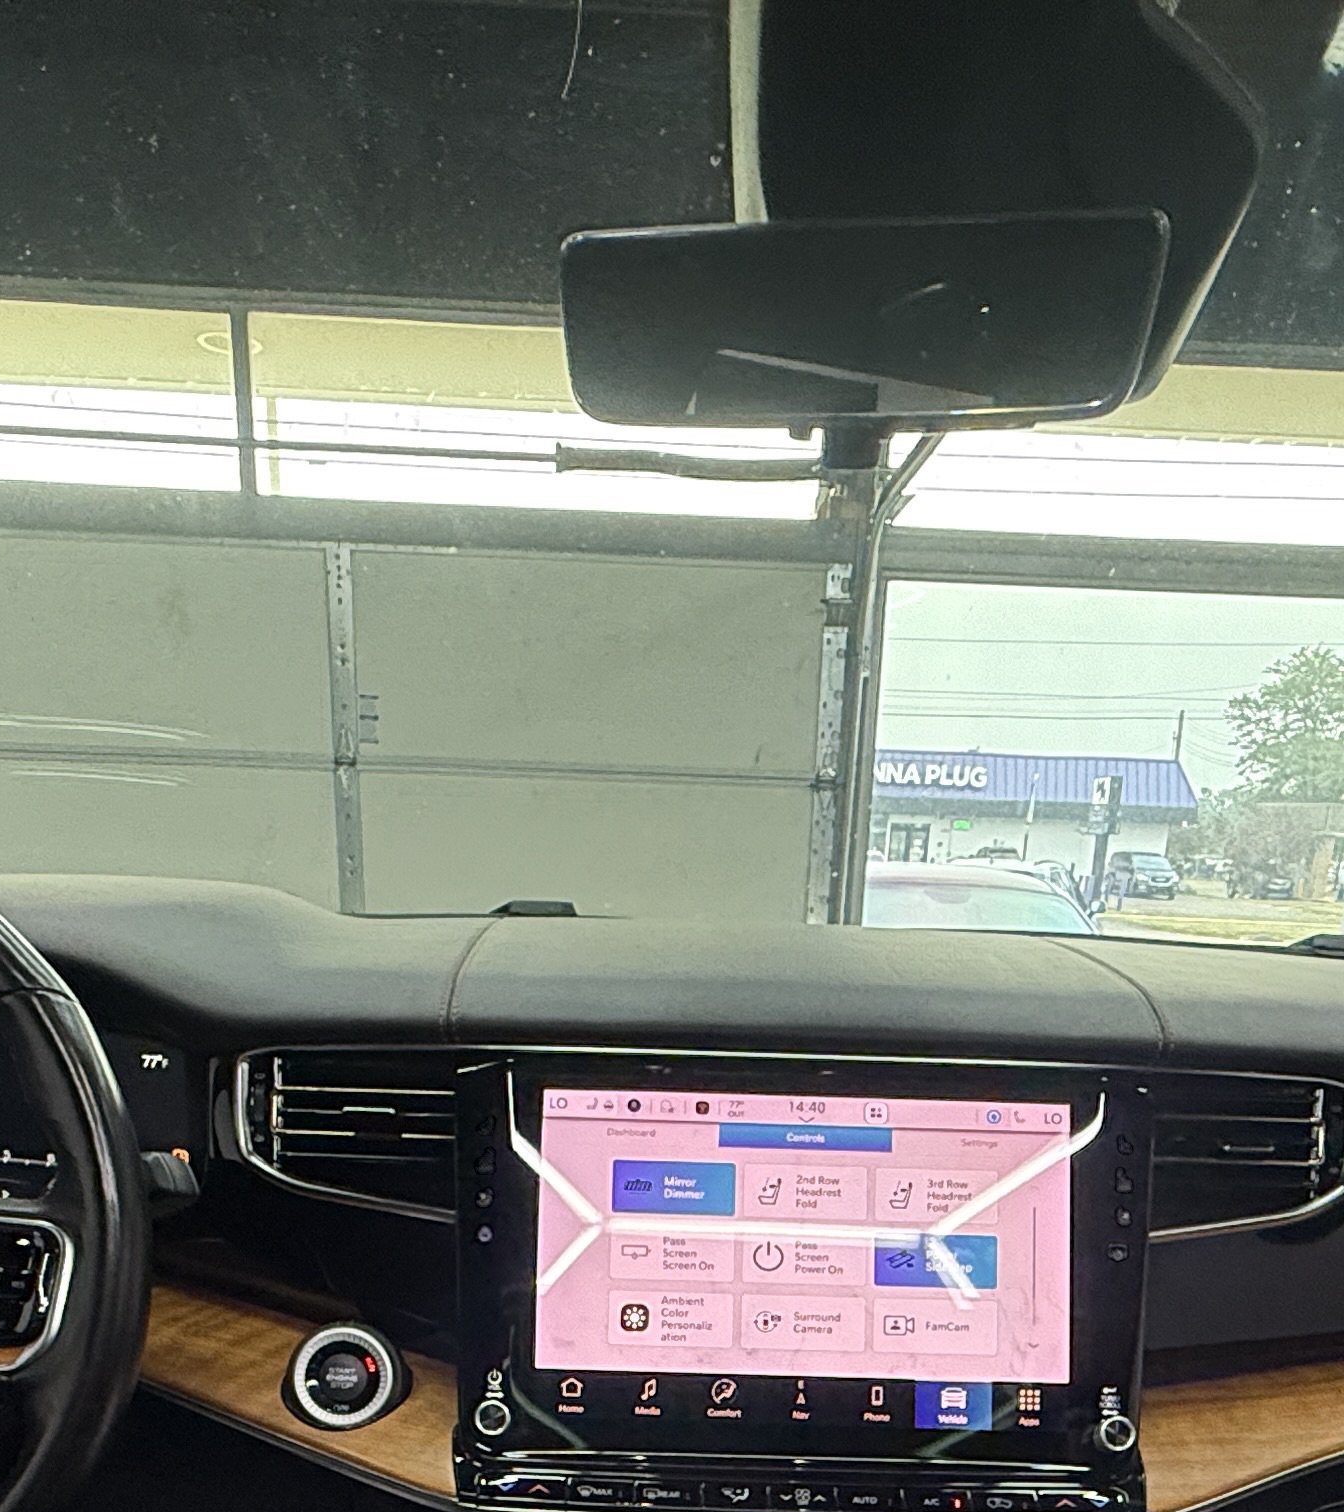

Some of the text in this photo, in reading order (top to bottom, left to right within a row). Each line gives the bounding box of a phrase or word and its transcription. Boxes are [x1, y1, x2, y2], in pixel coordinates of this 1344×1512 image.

[926, 763, 987, 788] PLUG
[549, 1097, 568, 1109] LO
[788, 1101, 826, 1113] 14:40
[1043, 1112, 1063, 1125] LO
[606, 1127, 656, 1138] Dashboard
[786, 1132, 826, 1144] Controls
[961, 1138, 999, 1149] Settings
[664, 1175, 697, 1187] Mirror
[795, 1175, 840, 1186] 2nd Row
[926, 1178, 969, 1190] 3rd Row
[663, 1188, 705, 1200] Dimmer
[795, 1187, 842, 1198] Headrest
[926, 1190, 973, 1202] Headrest
[795, 1198, 818, 1209] Fold
[926, 1202, 949, 1213] Fold
[663, 1235, 687, 1246] Pass
[794, 1240, 818, 1250] Pass
[662, 1248, 698, 1259] Screen
[794, 1252, 829, 1262] Screen
[662, 1260, 715, 1272] Screen On
[794, 1264, 844, 1275] Power On
[660, 1296, 705, 1306] Ambient
[660, 1308, 689, 1318] Color
[793, 1311, 841, 1323] Surround
[660, 1320, 713, 1331] Personaliz
[793, 1324, 833, 1335] Camera
[925, 1321, 970, 1332] FamCam
[660, 1333, 687, 1342] ation
[330, 1382, 354, 1390] STOP
[558, 1404, 1041, 1428] Home Media Comfort Nav Phone Vehicle Apps
[593, 1488, 613, 1497] MAX
[852, 1496, 878, 1505] AUTO
[923, 1497, 940, 1506] A/C
